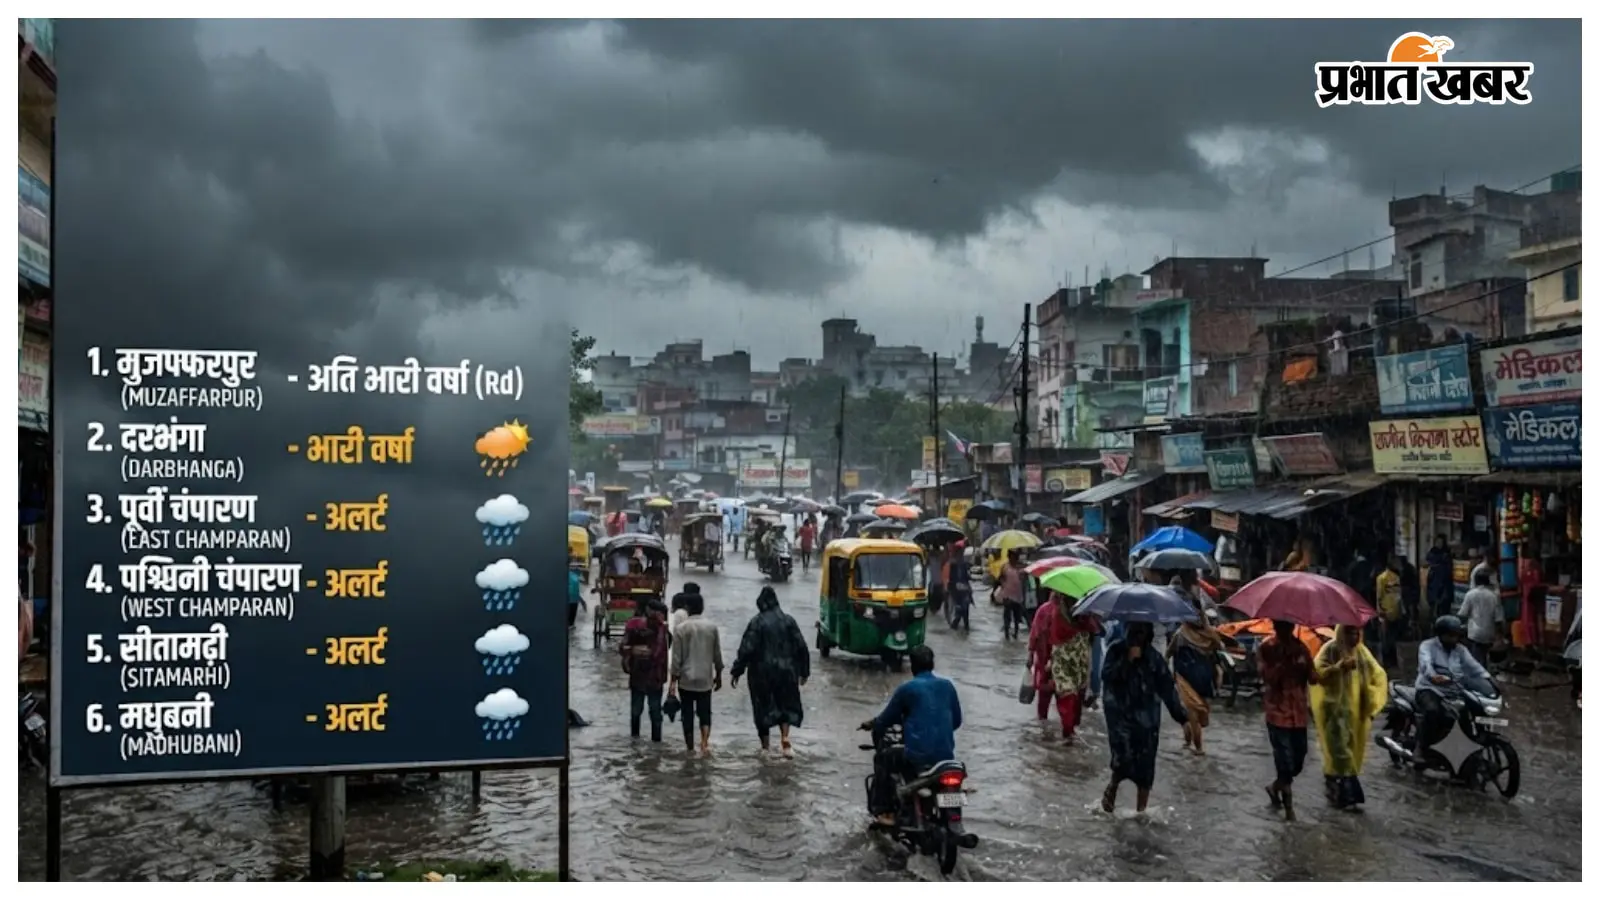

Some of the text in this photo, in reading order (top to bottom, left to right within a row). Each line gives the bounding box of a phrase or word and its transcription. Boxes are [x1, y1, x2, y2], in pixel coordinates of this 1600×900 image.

[87, 347, 109, 376] 1.
[307, 355, 359, 394] अति
[364, 357, 421, 394] भारी
[424, 359, 470, 394] वर्षा
[475, 364, 524, 401] (Rd)
[121, 384, 263, 411] (MUZAFFARPUR)
[87, 416, 207, 452] 2. दरभंगा
[306, 425, 365, 463] भारी
[368, 426, 416, 463] वर्षा
[1501, 410, 1579, 442] मेडिकल
[121, 455, 244, 481] (DARBHANGA)
[86, 494, 112, 523] 3.
[169, 487, 258, 523] चंपारण
[324, 493, 388, 531] अलर्ट
[121, 526, 291, 553] (EAST CHAMPARAN)
[85, 564, 113, 593] 4.
[214, 556, 302, 592] चंपारण
[324, 560, 388, 598] अलर्ट
[121, 593, 294, 620] (WEST CHAMPARAN)
[86, 634, 112, 663] 5.
[324, 626, 388, 665] अलर्ट
[120, 662, 231, 692] (SITAMARHI)
[86, 692, 214, 738] 6. मधुबनी
[324, 693, 388, 731] अलर्ट
[120, 729, 242, 760] (MADHUBANI)
